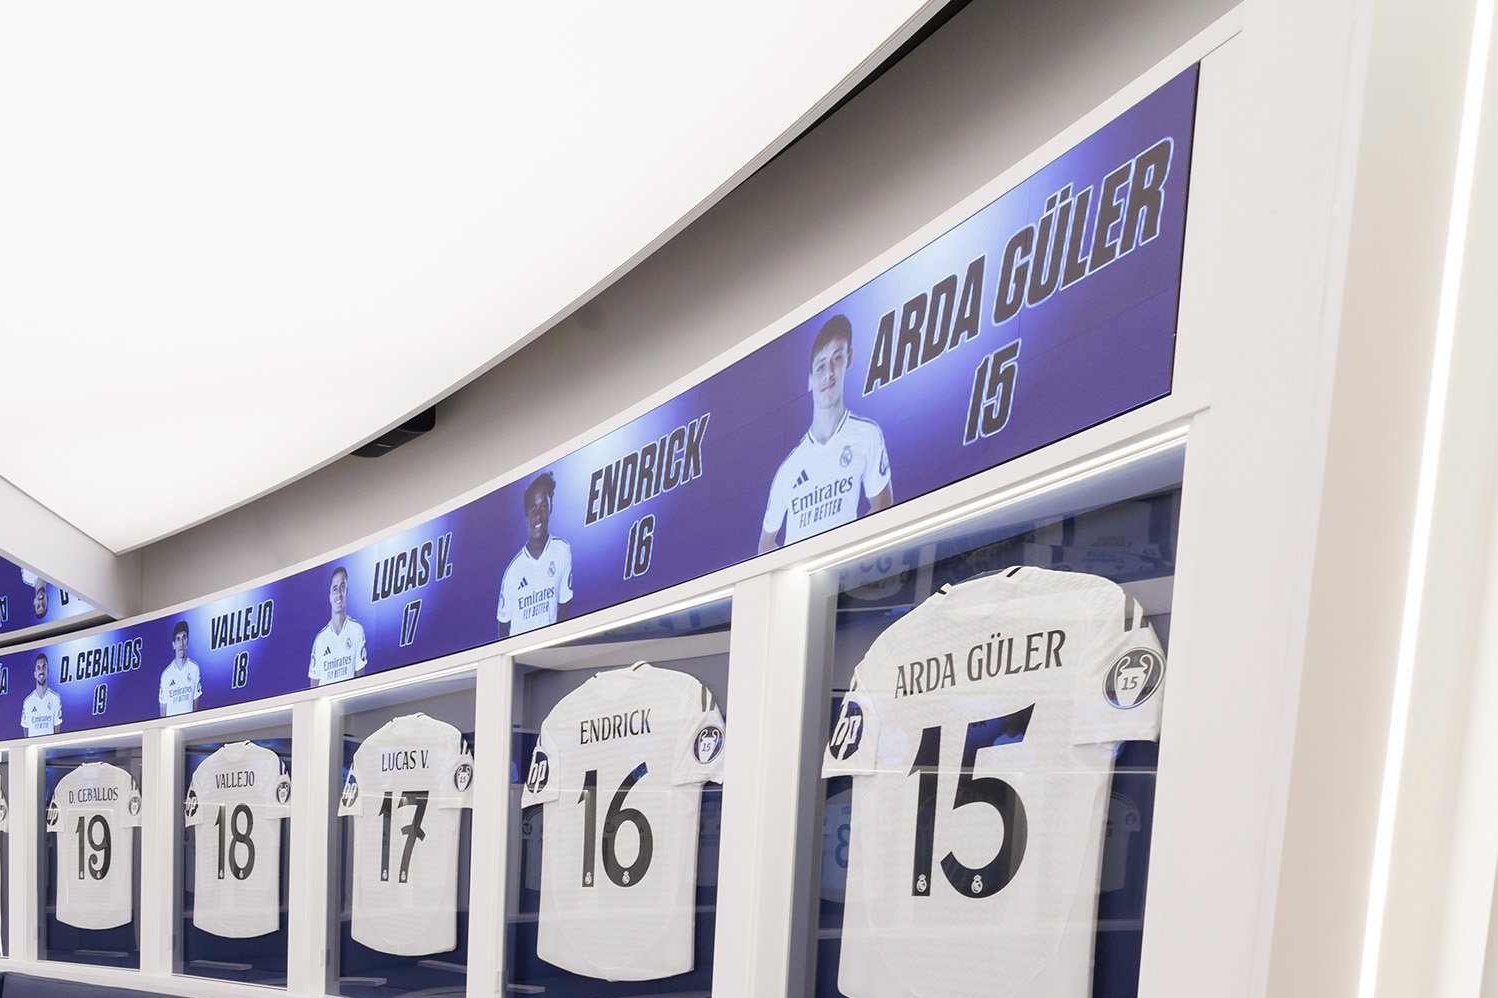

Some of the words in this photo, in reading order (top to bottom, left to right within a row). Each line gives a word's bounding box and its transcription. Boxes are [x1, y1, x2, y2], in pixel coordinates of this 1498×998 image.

[862, 253, 987, 397] ARDA
[991, 136, 1175, 326] GÜLER
[963, 338, 1022, 446] 15
[584, 412, 711, 527] ENDRICK
[791, 476, 853, 515] Emirates
[799, 509, 813, 528] FLY
[813, 497, 843, 523] BETTER
[371, 540, 432, 603] LUCAS
[436, 532, 453, 581] V.
[623, 514, 655, 580] 16
[518, 587, 555, 610] Emirates
[523, 607, 532, 620] FLY
[532, 601, 549, 617] BETTER
[210, 599, 274, 651] VALLEJO
[400, 599, 422, 647] 17
[59, 656, 72, 684] D.
[76, 638, 142, 681] CEBALLOS
[232, 651, 249, 689] 18
[324, 655, 352, 671] Emirates
[894, 653, 956, 699] ARDA
[967, 629, 1067, 682] GÜLER
[1122, 676, 1139, 691] 15
[93, 684, 107, 715] 19
[580, 708, 652, 745] ENDRICK
[702, 743, 711, 752] 15
[830, 702, 862, 760] hp
[215, 771, 255, 789] VALLEJO
[381, 750, 416, 772] LUCAS
[419, 750, 430, 769] V.
[529, 753, 548, 793] hp
[68, 790, 76, 803] D.
[77, 787, 119, 803] CEBALLOS
[907, 702, 1036, 899] 15
[75, 814, 112, 881] 19
[215, 803, 256, 880] 18
[378, 790, 429, 883] 17
[576, 761, 654, 888] 16
